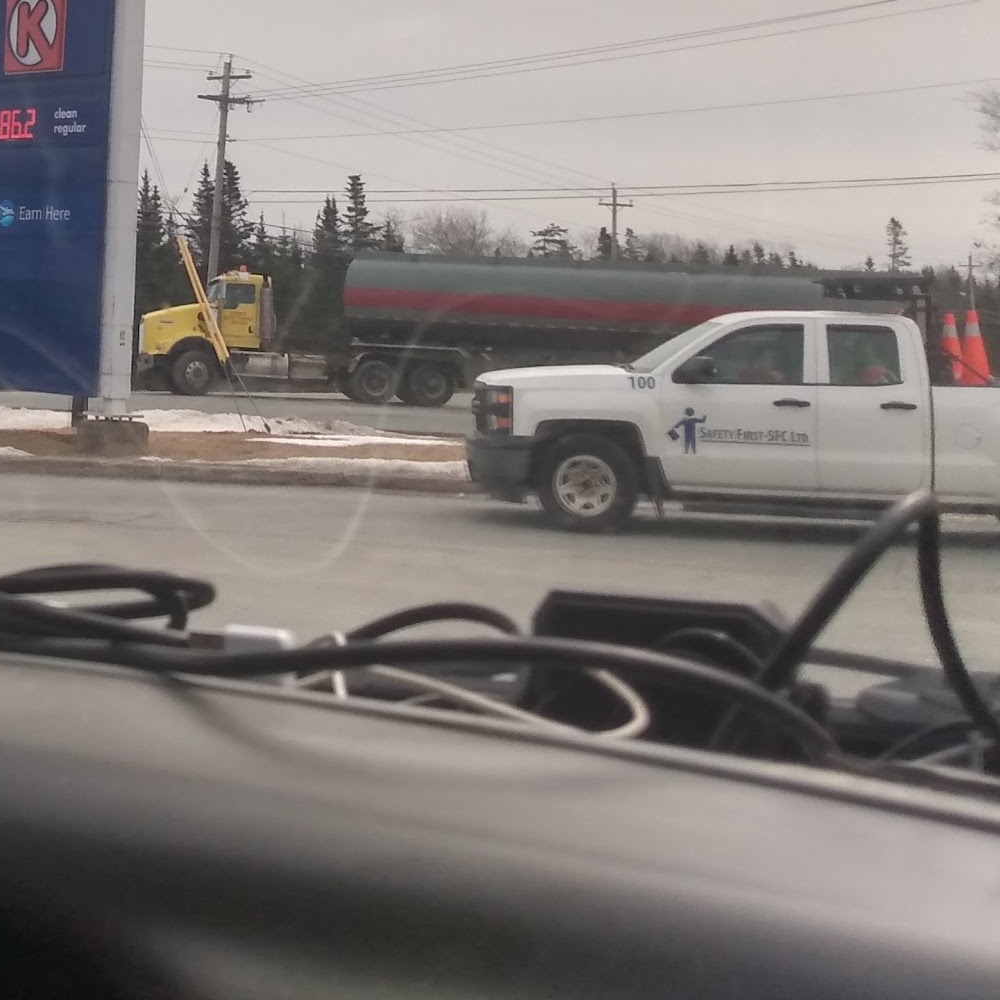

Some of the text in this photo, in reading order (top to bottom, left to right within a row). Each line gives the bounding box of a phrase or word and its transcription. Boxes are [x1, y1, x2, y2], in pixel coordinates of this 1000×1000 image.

[54, 107, 78, 119] clean
[54, 121, 87, 136] regular
[19, 206, 70, 220] Earn Here
[628, 376, 655, 389] 100
